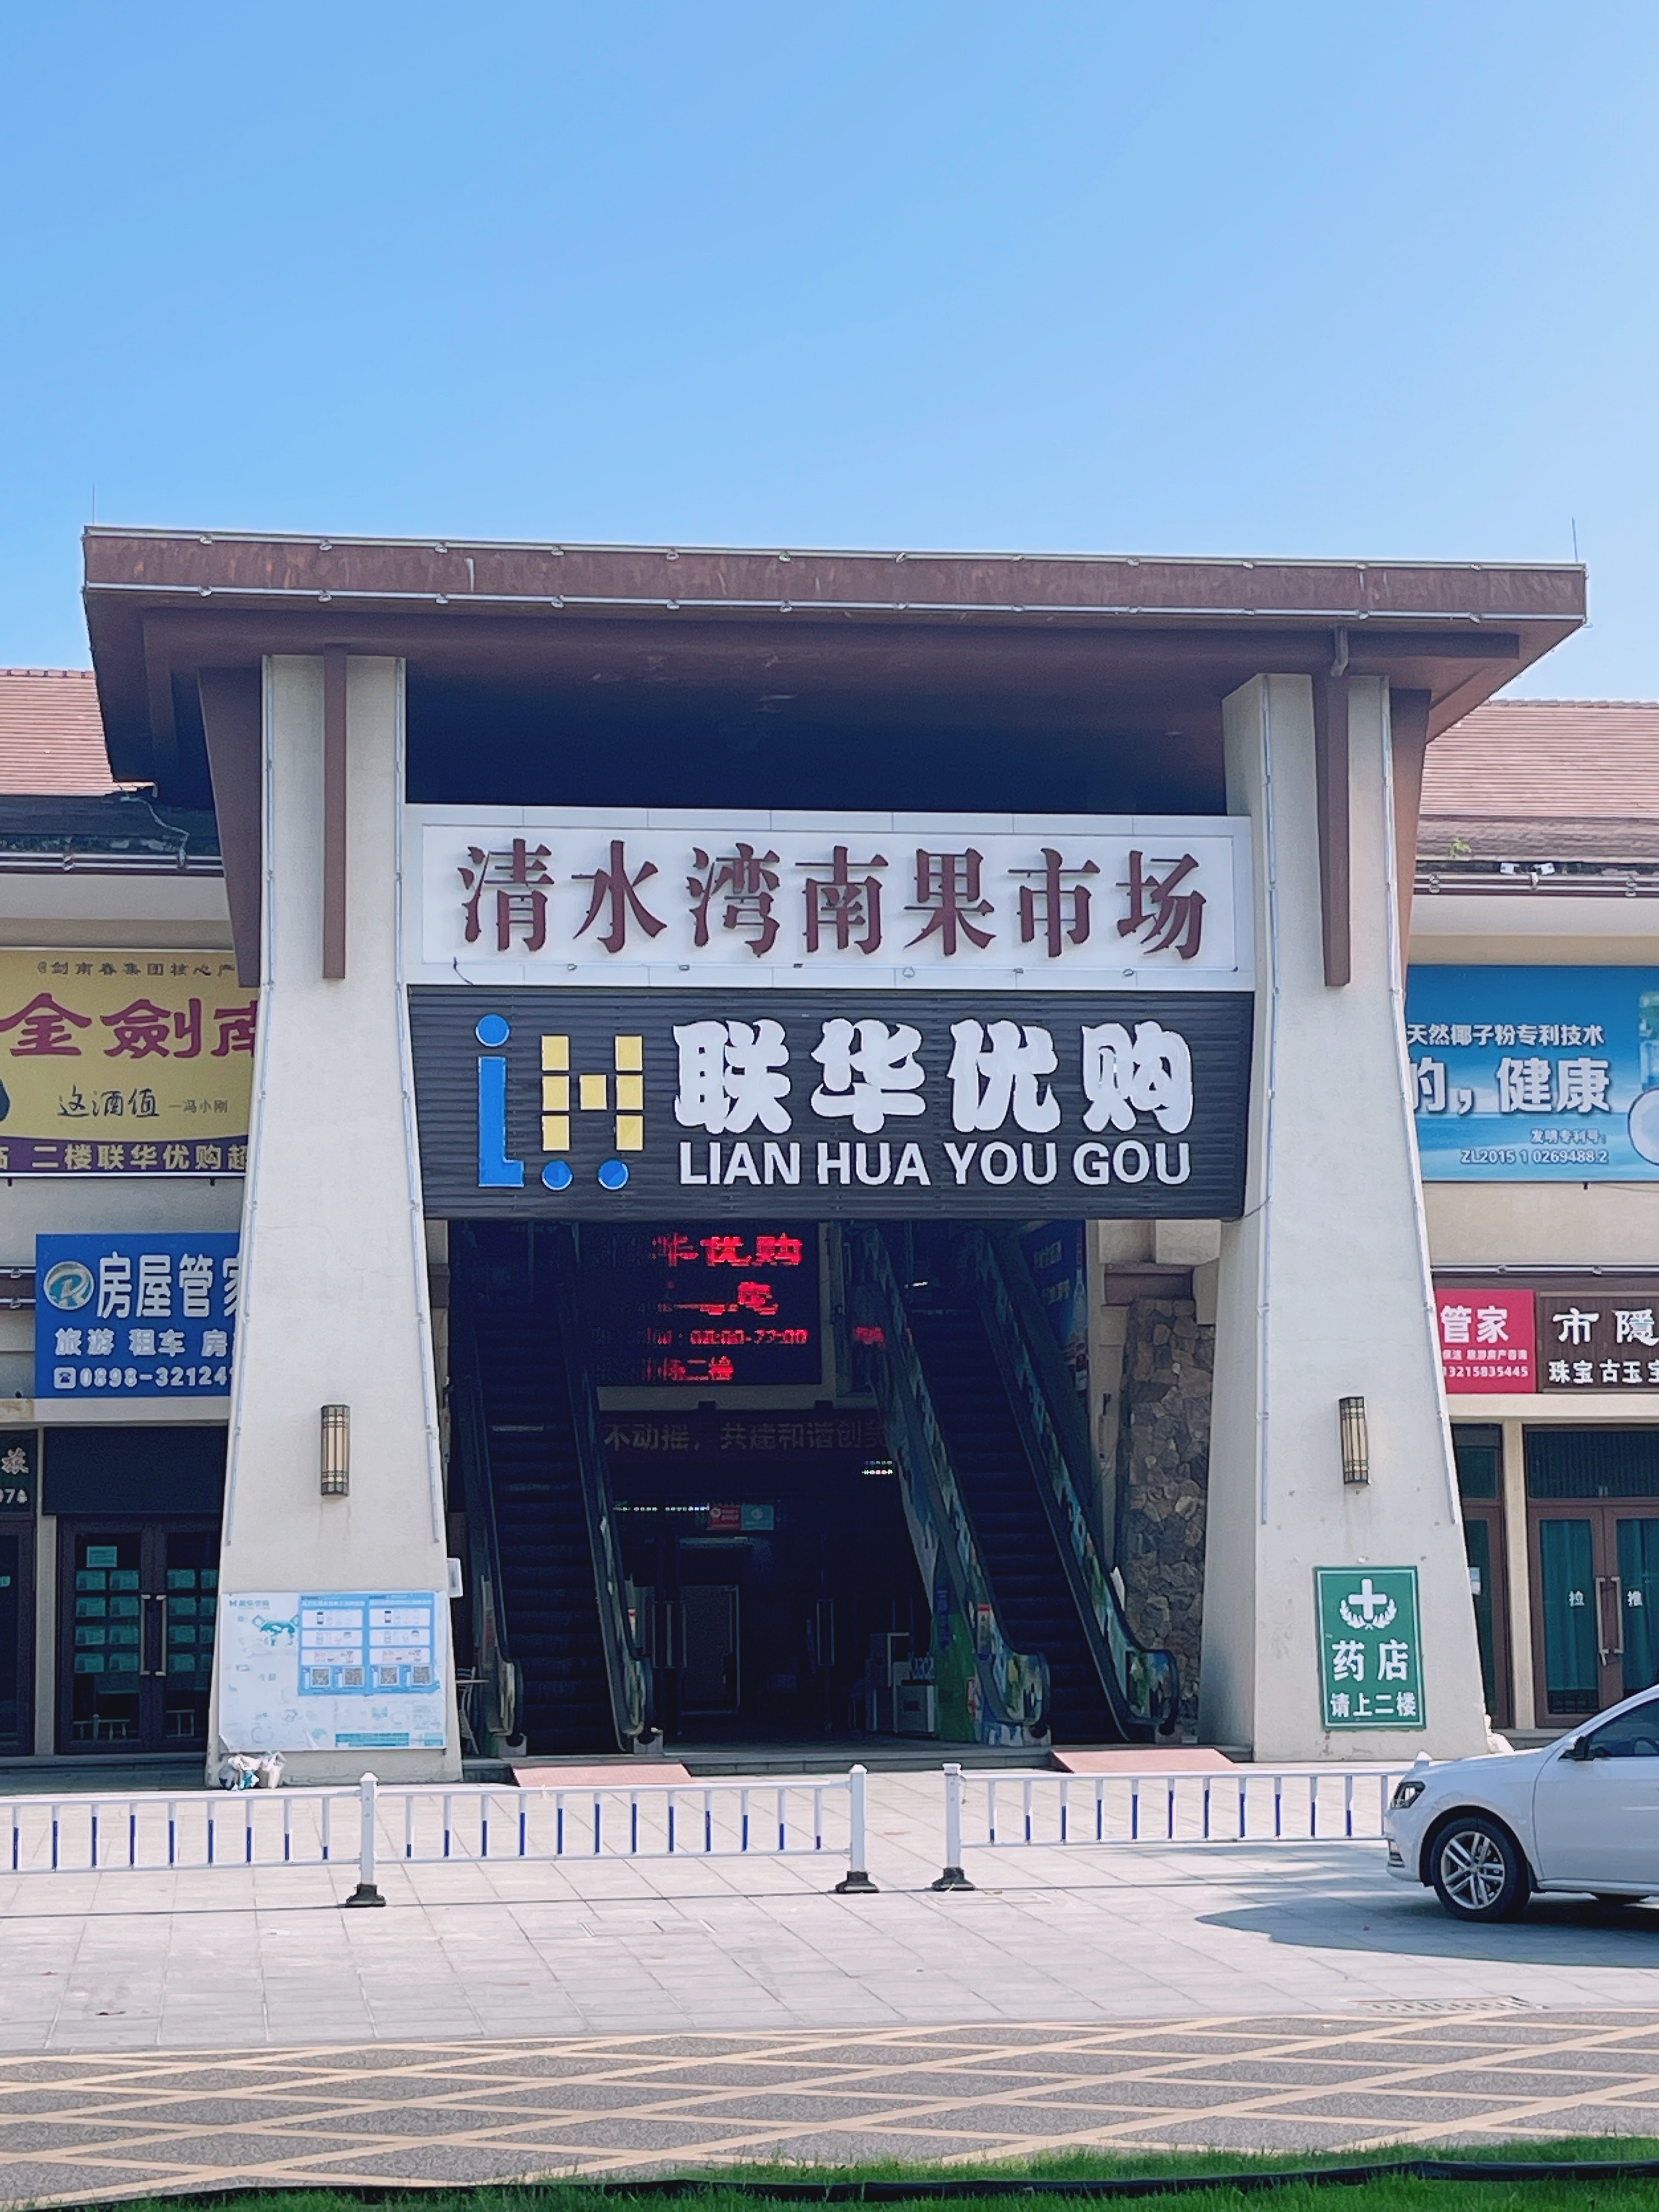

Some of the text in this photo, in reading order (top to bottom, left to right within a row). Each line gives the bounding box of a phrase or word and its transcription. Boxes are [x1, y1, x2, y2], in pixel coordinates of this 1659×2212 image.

[458, 838, 1208, 960] 清水湾南果市场
[1407, 1024, 1605, 1046] 天然椰子粉专利技术
[673, 1018, 1194, 1132] 联华优购
[680, 1142, 1190, 1186] LIAN HUA YOU GOU
[1462, 1150, 1515, 1163] ZL2015
[1441, 1305, 1509, 1344] 管家
[55, 1328, 115, 1356] 旅游
[129, 1328, 185, 1357] 租车
[80, 1366, 233, 1387] 0898-32124
[1331, 1639, 1408, 1681] 药店
[1330, 1691, 1416, 1718] 请上二楼
